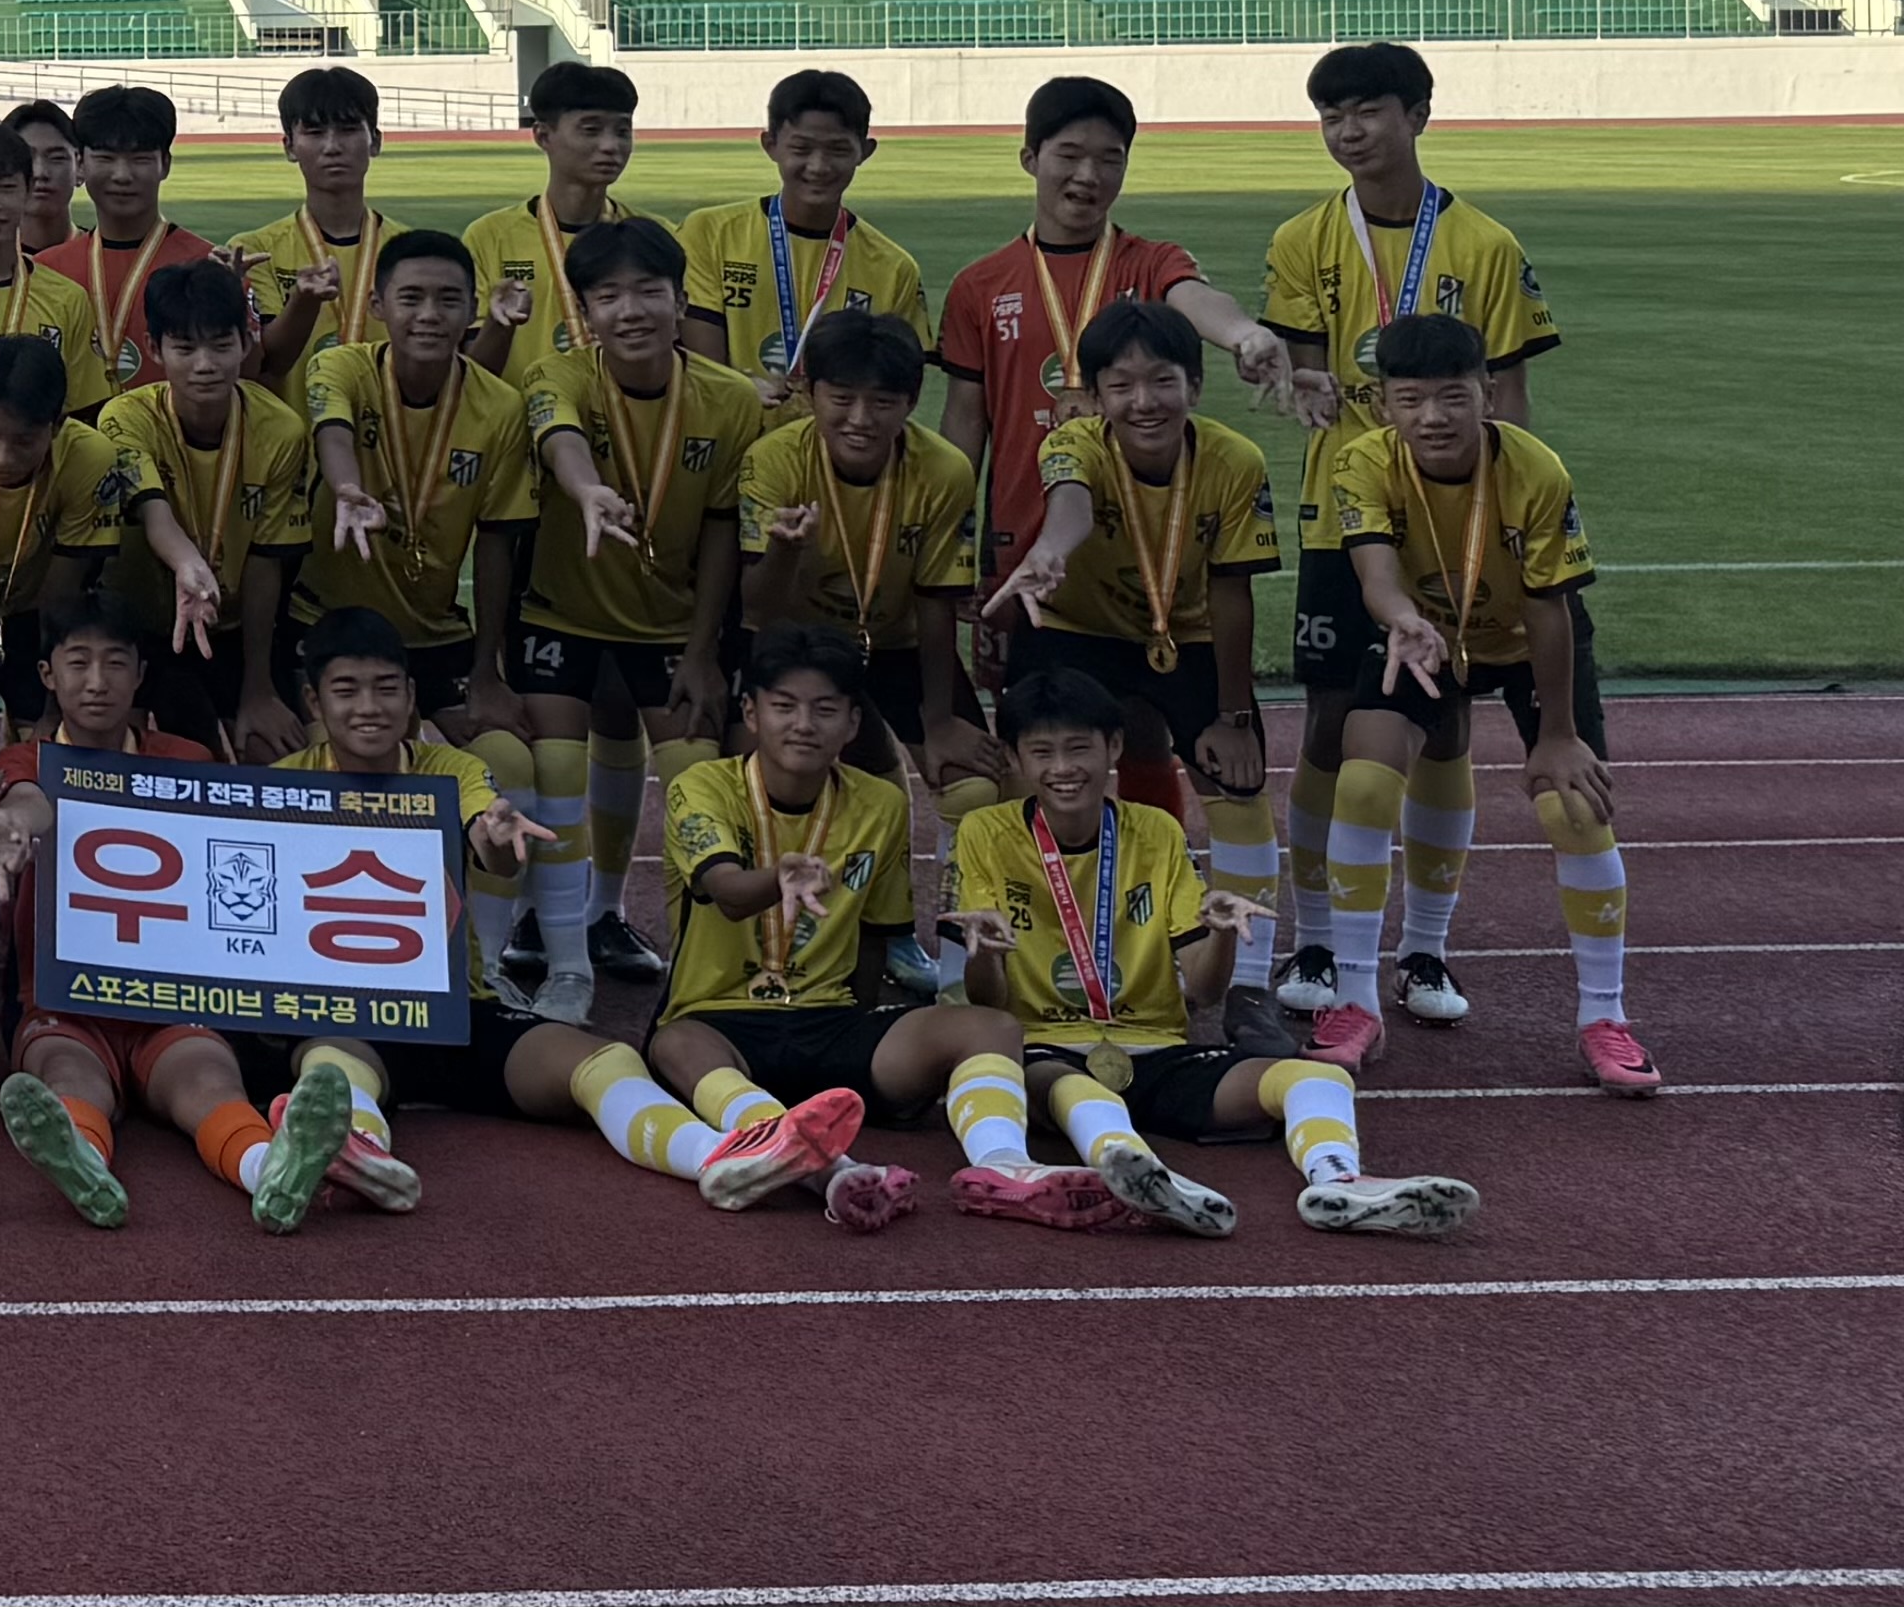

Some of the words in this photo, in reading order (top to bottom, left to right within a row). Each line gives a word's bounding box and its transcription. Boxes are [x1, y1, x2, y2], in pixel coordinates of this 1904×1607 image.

[724, 270, 757, 285] PSPS
[724, 286, 752, 308] 25
[997, 318, 1020, 342] 51
[1296, 612, 1337, 651] 26
[523, 636, 565, 669] 14
[62, 766, 124, 794] 제63회
[130, 772, 201, 804] 청룡기
[207, 781, 254, 808] 전국
[261, 785, 334, 814] 중학교
[339, 790, 436, 818] 축구대회
[69, 827, 189, 945] 우
[300, 849, 427, 965] 승
[1008, 906, 1033, 931] 29
[225, 936, 266, 956] KFA
[69, 972, 263, 1019] 스포츠트라이브
[273, 993, 357, 1024] 축구공
[369, 999, 429, 1029] 10개
